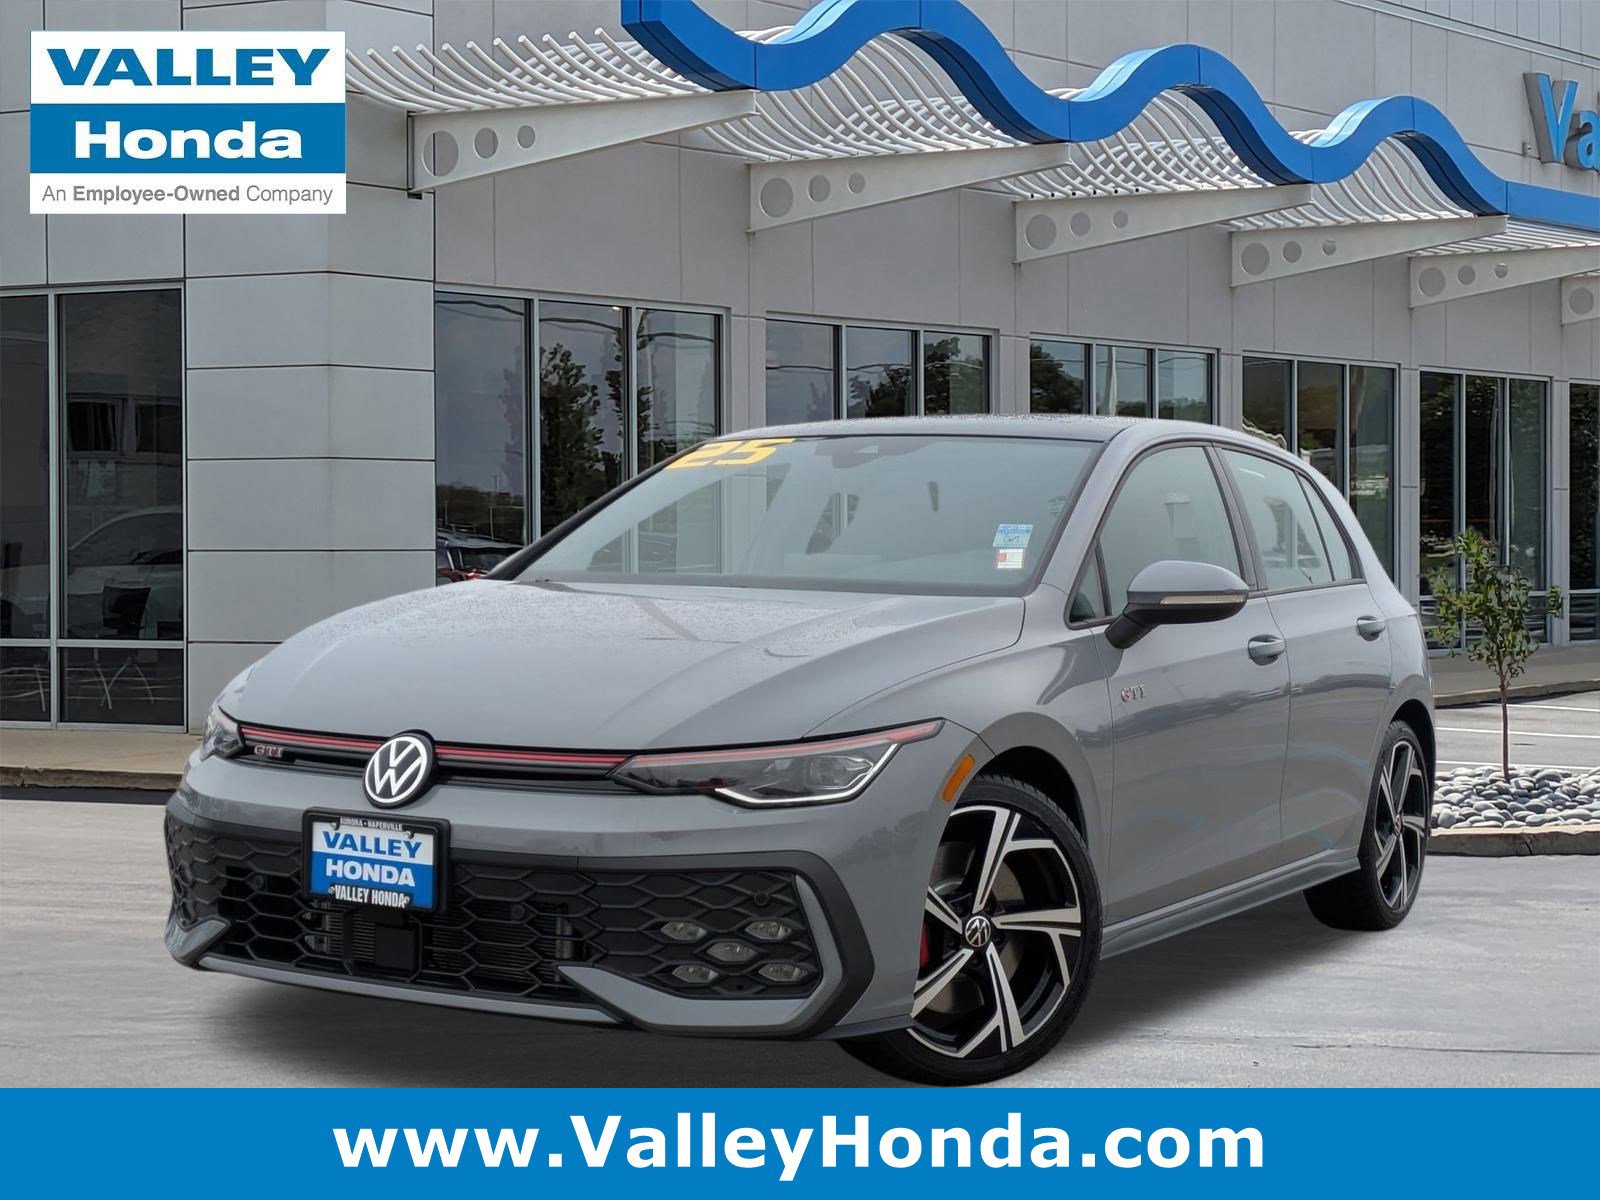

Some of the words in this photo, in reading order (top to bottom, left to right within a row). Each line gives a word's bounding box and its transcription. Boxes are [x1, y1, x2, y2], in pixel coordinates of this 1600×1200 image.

[665, 438, 797, 470] 25
[254, 744, 283, 759] GTI
[367, 820, 403, 832] NAPERVILLE
[322, 830, 422, 859] VALLEY
[325, 858, 416, 888] HONDA
[334, 884, 370, 904] VALLEY
[371, 889, 407, 909] HONDA
